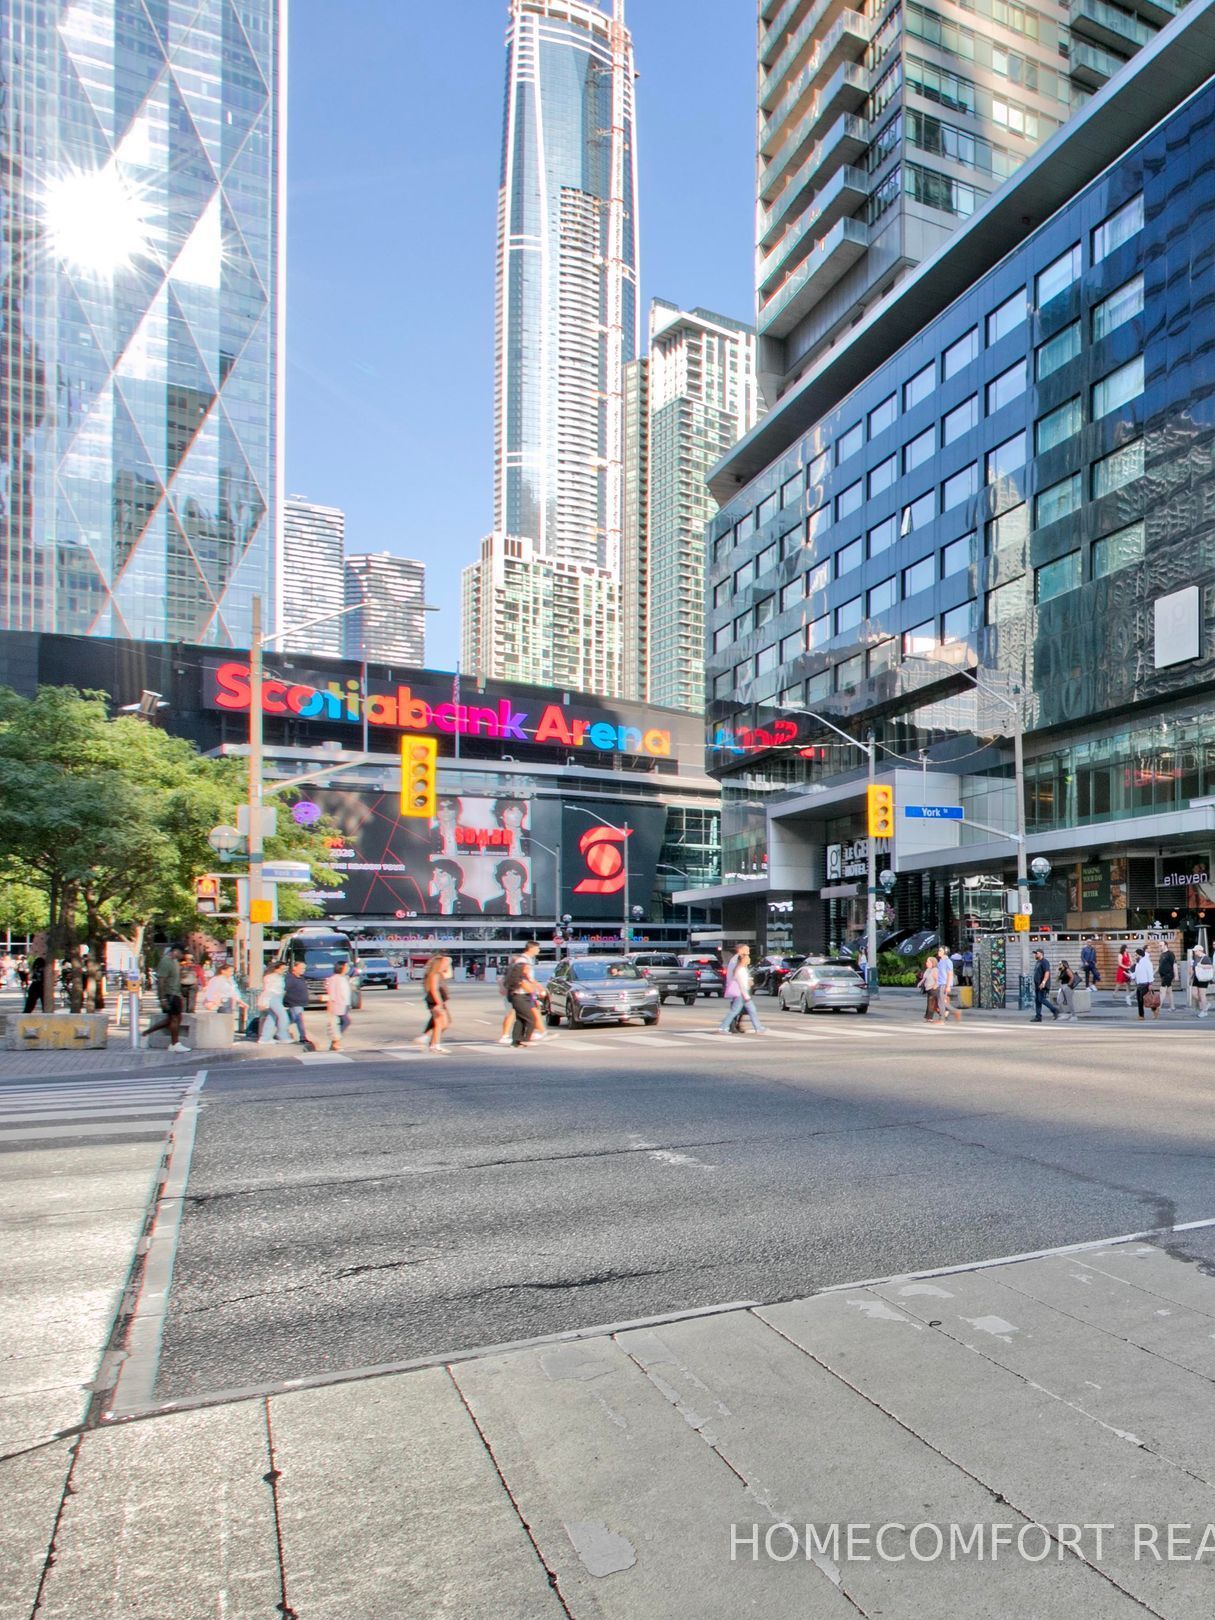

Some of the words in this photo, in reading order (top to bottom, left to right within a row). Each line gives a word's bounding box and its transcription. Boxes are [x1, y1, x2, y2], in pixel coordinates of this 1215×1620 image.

[215, 663, 528, 738] Scotiabank
[534, 704, 671, 756] Arena
[922, 808, 941, 816] York
[1164, 872, 1208, 886] elleven
